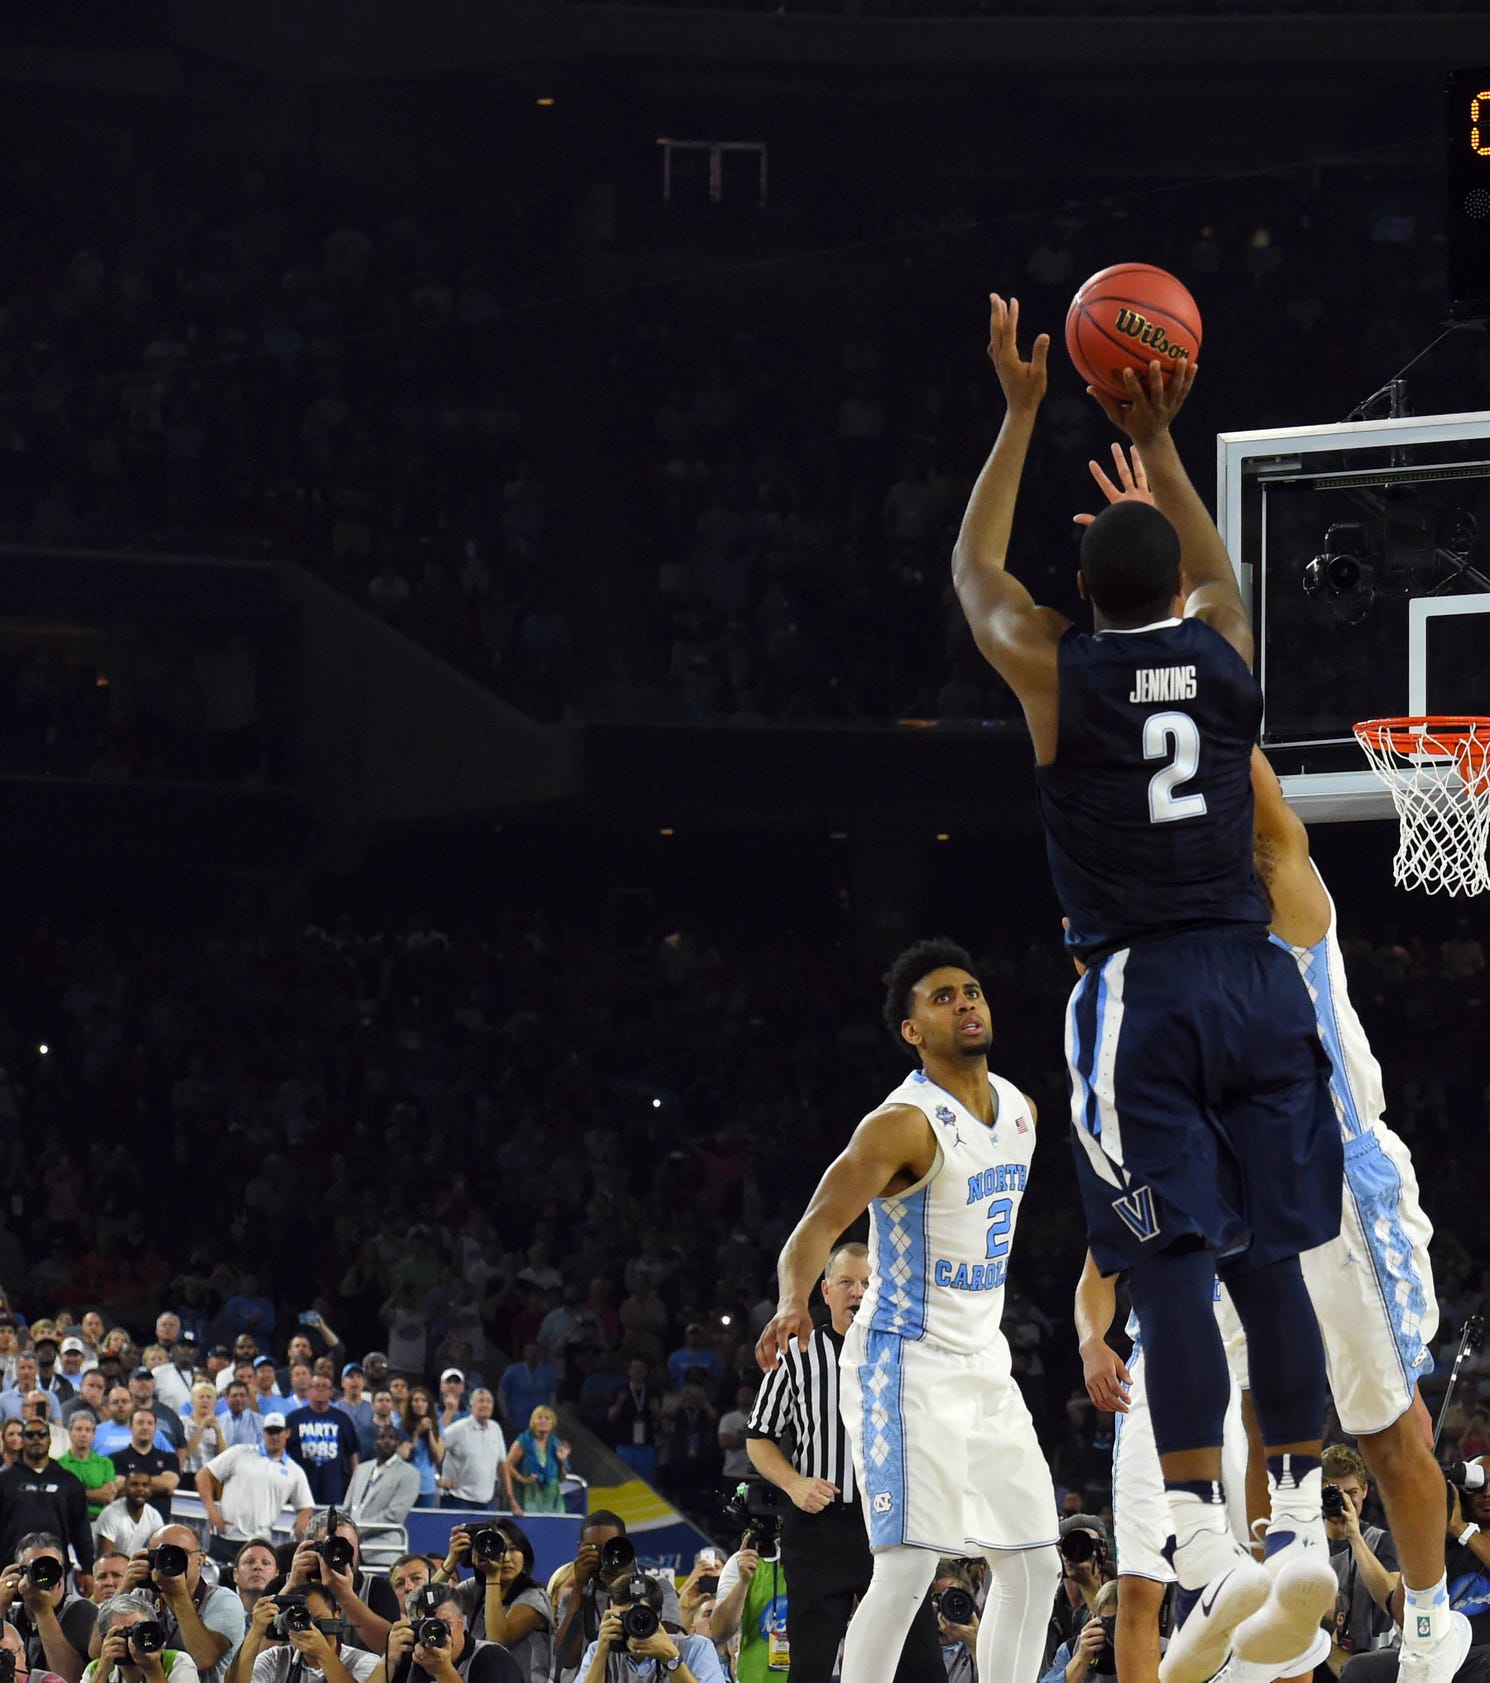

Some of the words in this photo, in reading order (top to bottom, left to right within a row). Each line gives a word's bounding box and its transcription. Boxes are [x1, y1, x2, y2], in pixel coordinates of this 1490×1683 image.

[1115, 307, 1190, 359] Wilson
[1129, 665, 1197, 703] JENKINS
[1142, 710, 1208, 824] 2
[966, 1163, 1028, 1205] NORTH
[984, 1197, 1014, 1260] 2
[298, 1422, 339, 1437] PARTY
